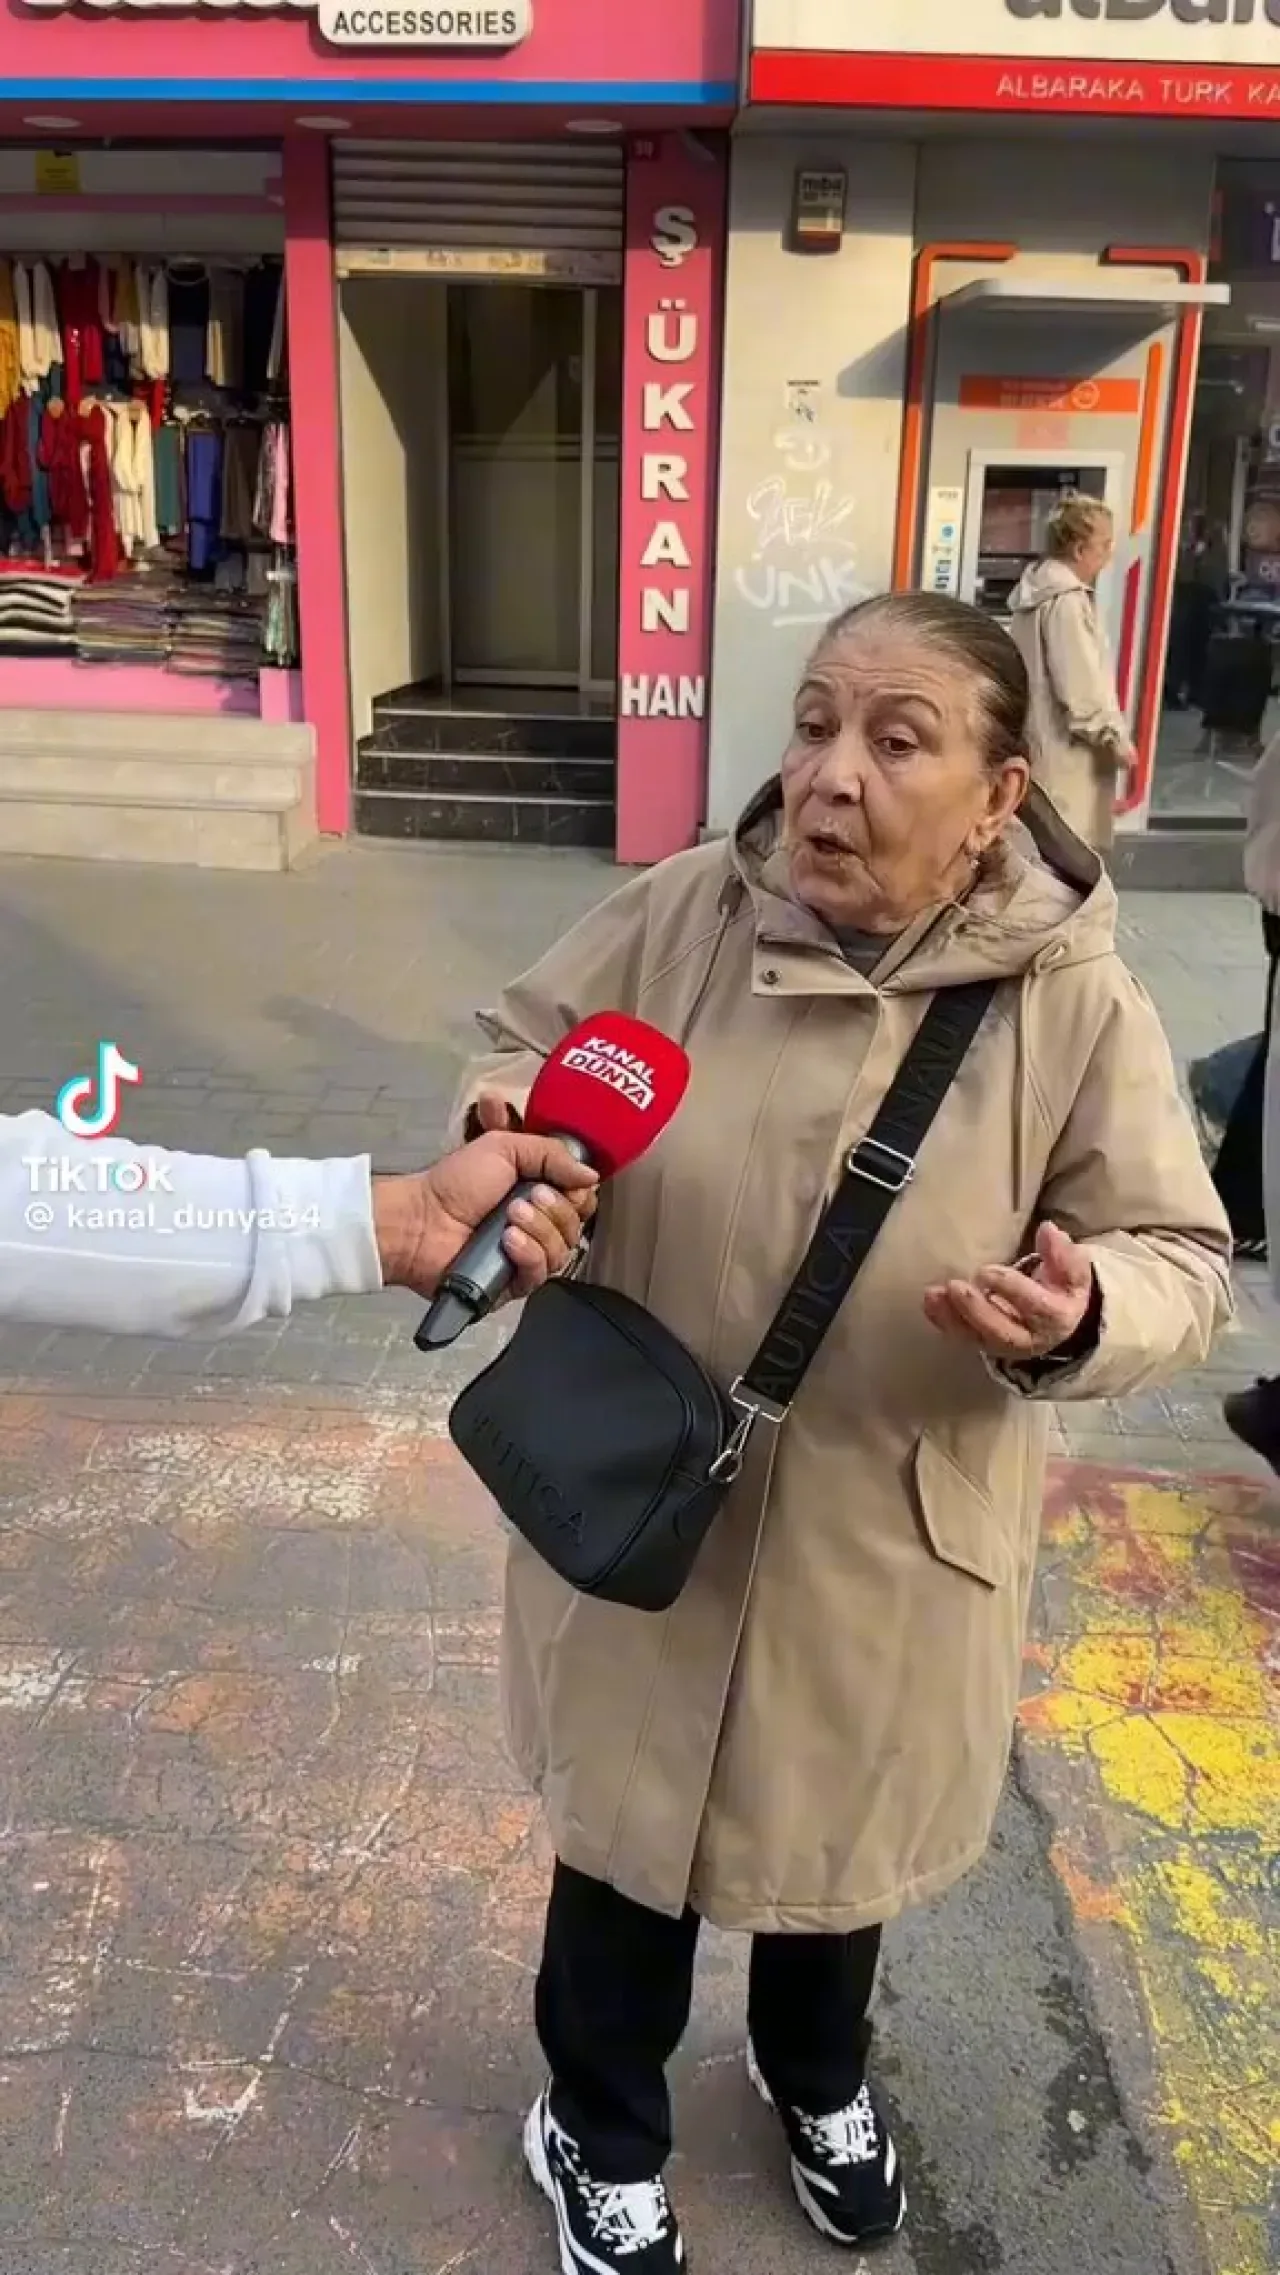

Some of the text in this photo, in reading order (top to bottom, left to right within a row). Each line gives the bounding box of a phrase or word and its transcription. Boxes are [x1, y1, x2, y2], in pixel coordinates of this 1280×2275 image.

[332, 11, 518, 36] ACCESSORIES
[996, 73, 1145, 101] ALBARAKA
[639, 205, 699, 633] ŞÜKRAN
[620, 673, 705, 718] HAN
[561, 1047, 656, 1111] DÜNYA
[582, 1036, 656, 1085] KANAL
[756, 1222, 868, 1400] AUTICA
